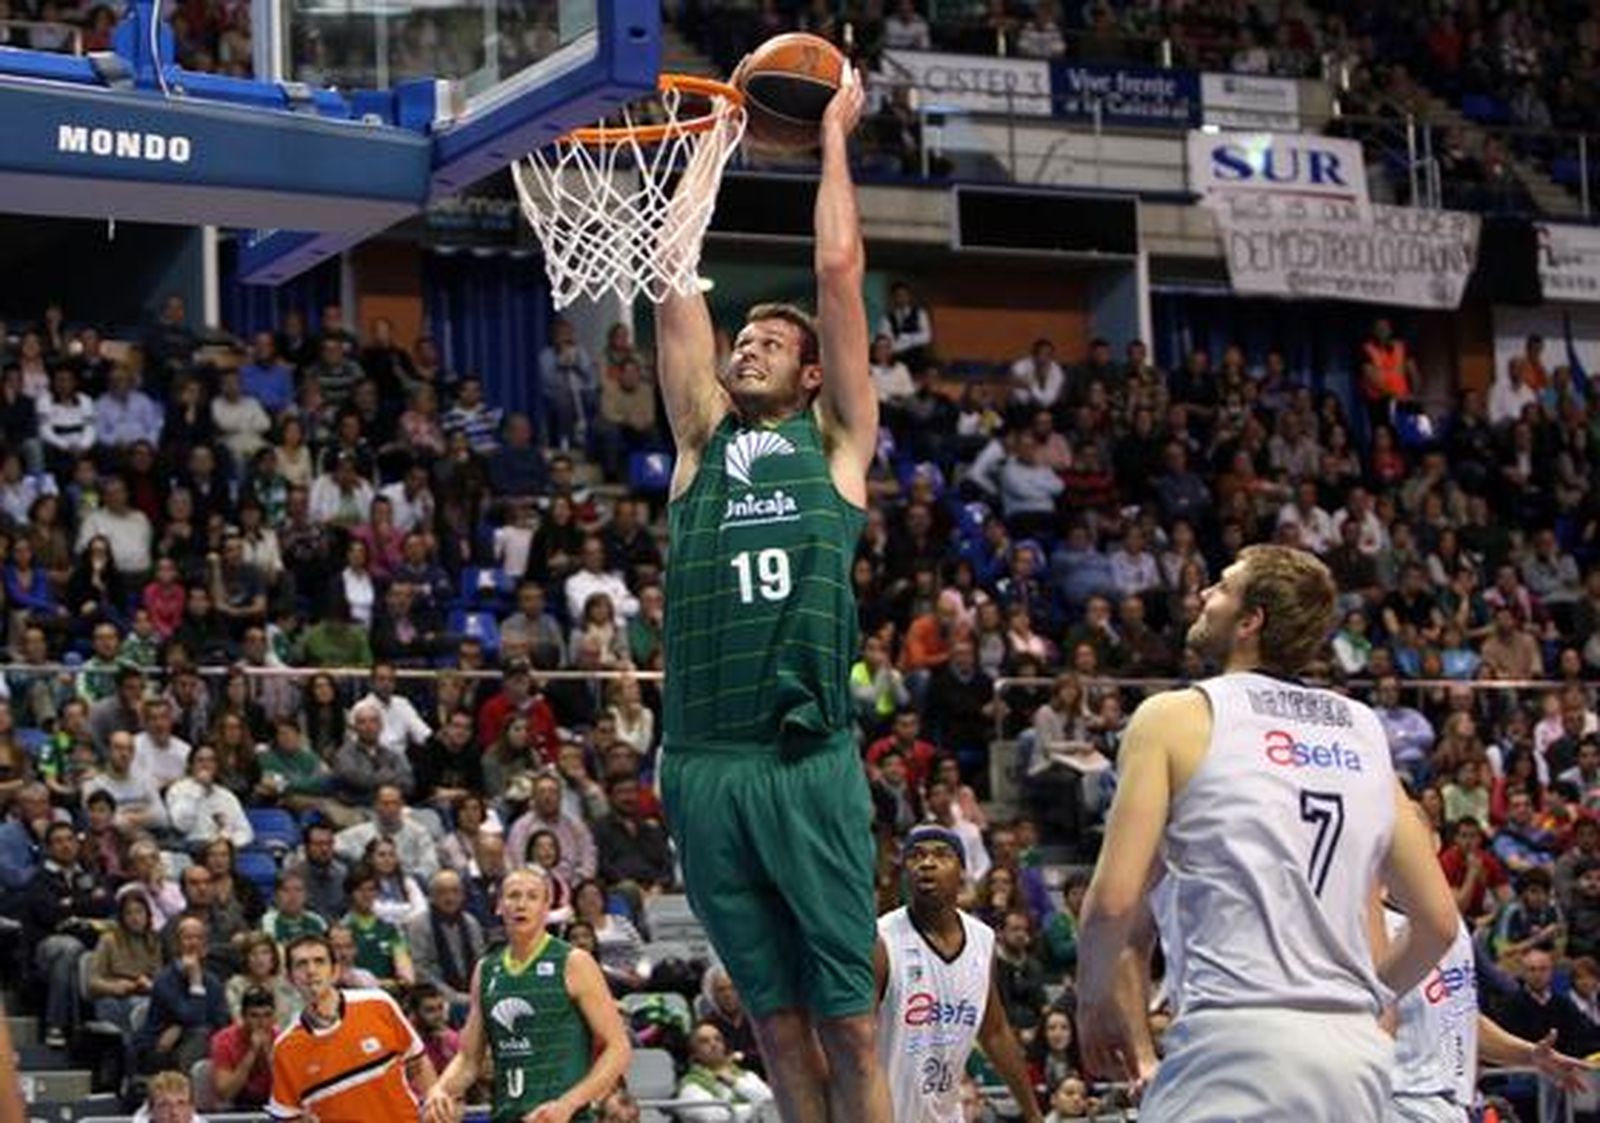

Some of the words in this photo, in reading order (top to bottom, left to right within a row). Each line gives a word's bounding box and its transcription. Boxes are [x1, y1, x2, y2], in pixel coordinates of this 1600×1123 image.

[58, 125, 190, 163] MONDO
[1211, 144, 1348, 187] SUR
[730, 548, 791, 604] 19
[1300, 789, 1344, 898] 7
